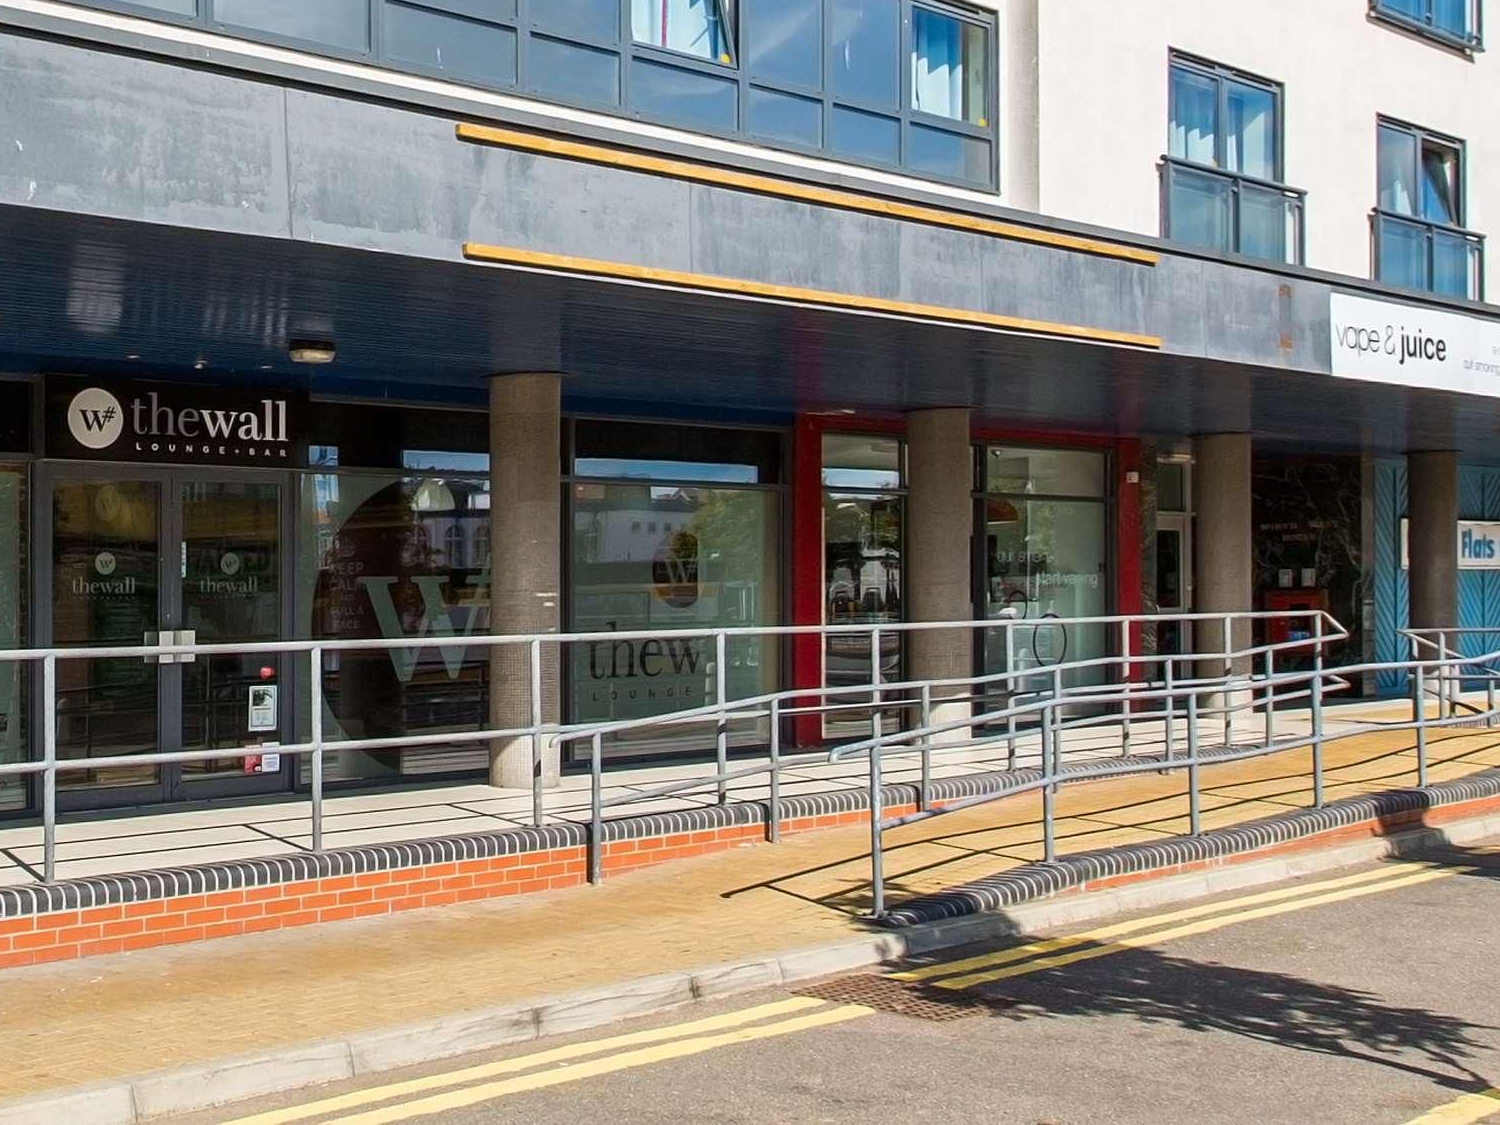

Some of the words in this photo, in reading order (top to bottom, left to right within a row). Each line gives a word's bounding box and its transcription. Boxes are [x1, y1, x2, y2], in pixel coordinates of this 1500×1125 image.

[1335, 323, 1380, 357] vape
[1384, 325, 1396, 356] &
[1399, 326, 1446, 365] juice
[135, 441, 226, 455] LOUNGE
[249, 448, 288, 458] BAR
[1461, 527, 1496, 560] Flats
[72, 576, 137, 595] thewall
[593, 687, 692, 702] LOUNGE
